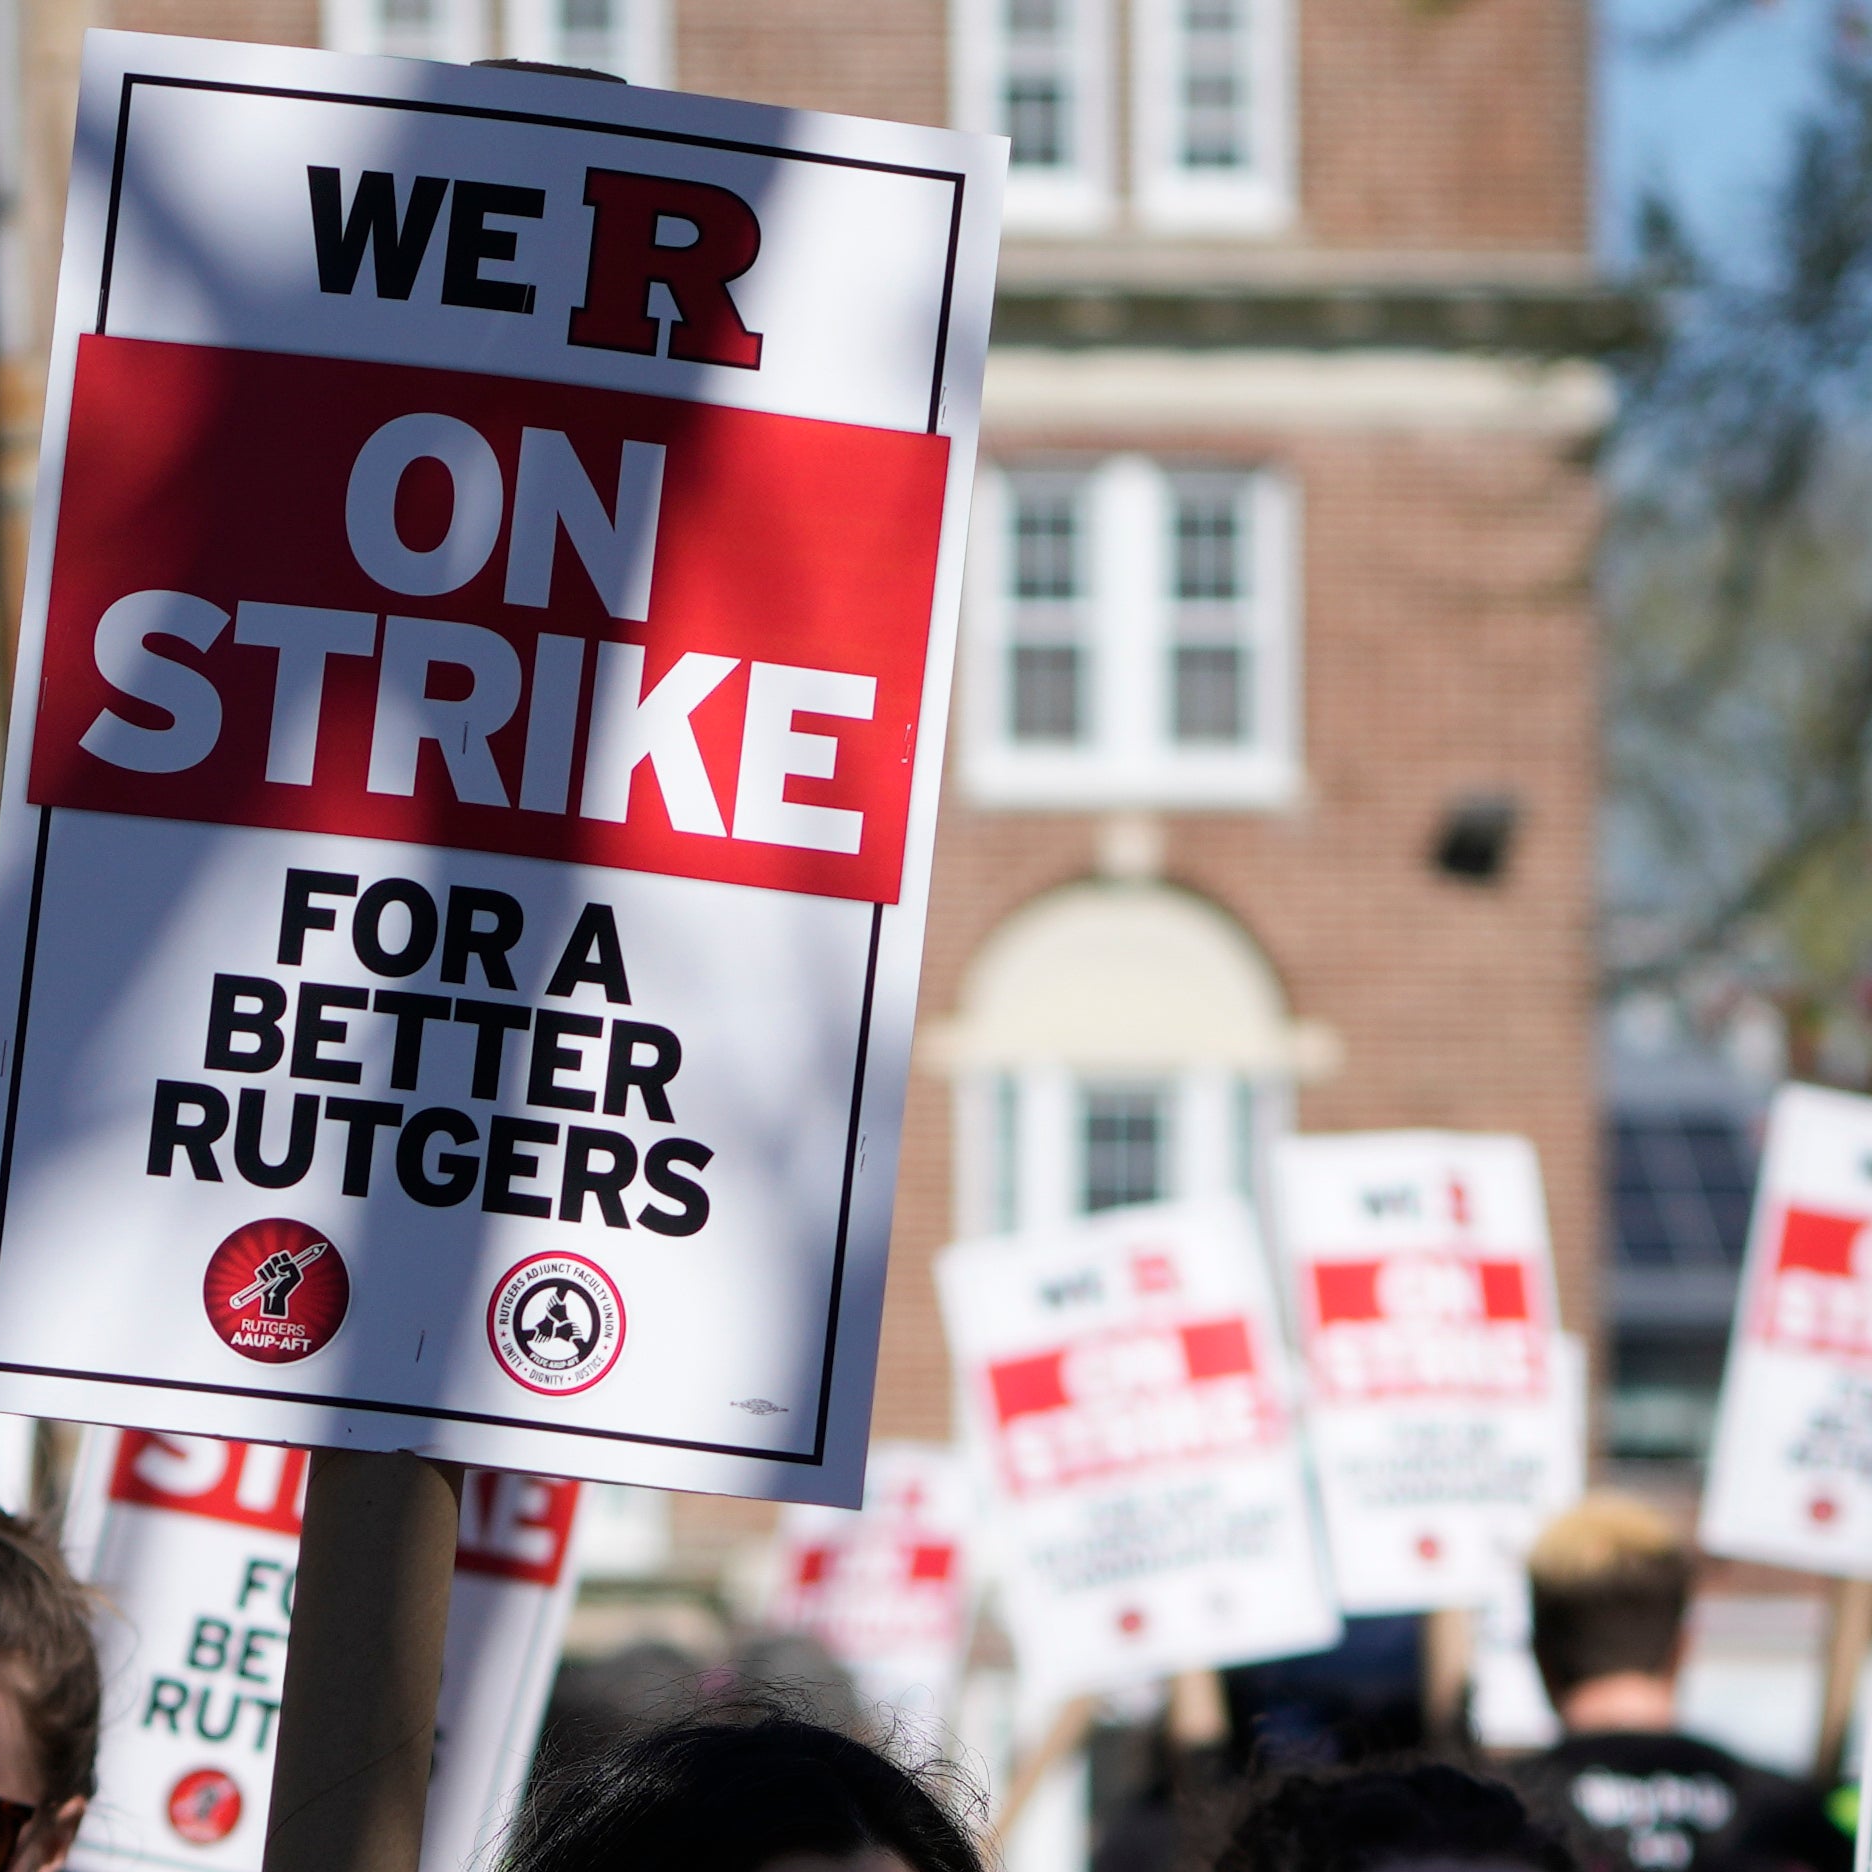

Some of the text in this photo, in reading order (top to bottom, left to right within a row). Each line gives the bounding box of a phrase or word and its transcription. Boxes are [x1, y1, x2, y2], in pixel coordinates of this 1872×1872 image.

[307, 166, 763, 370] WE R
[345, 412, 667, 622] ON
[78, 588, 877, 855] STRIKE
[276, 868, 632, 1005] FOR A
[205, 973, 683, 1123] BETTER
[146, 1079, 715, 1238] RUTGERS
[230, 1331, 312, 1352] AAUP-AFT
[241, 1318, 306, 1337] RUTGERS
[499, 1263, 615, 1339] RUTGERS ADJUNCT FACULTY UNION
[502, 1342, 605, 1386] UNITY DIGNITY JUSTICE
